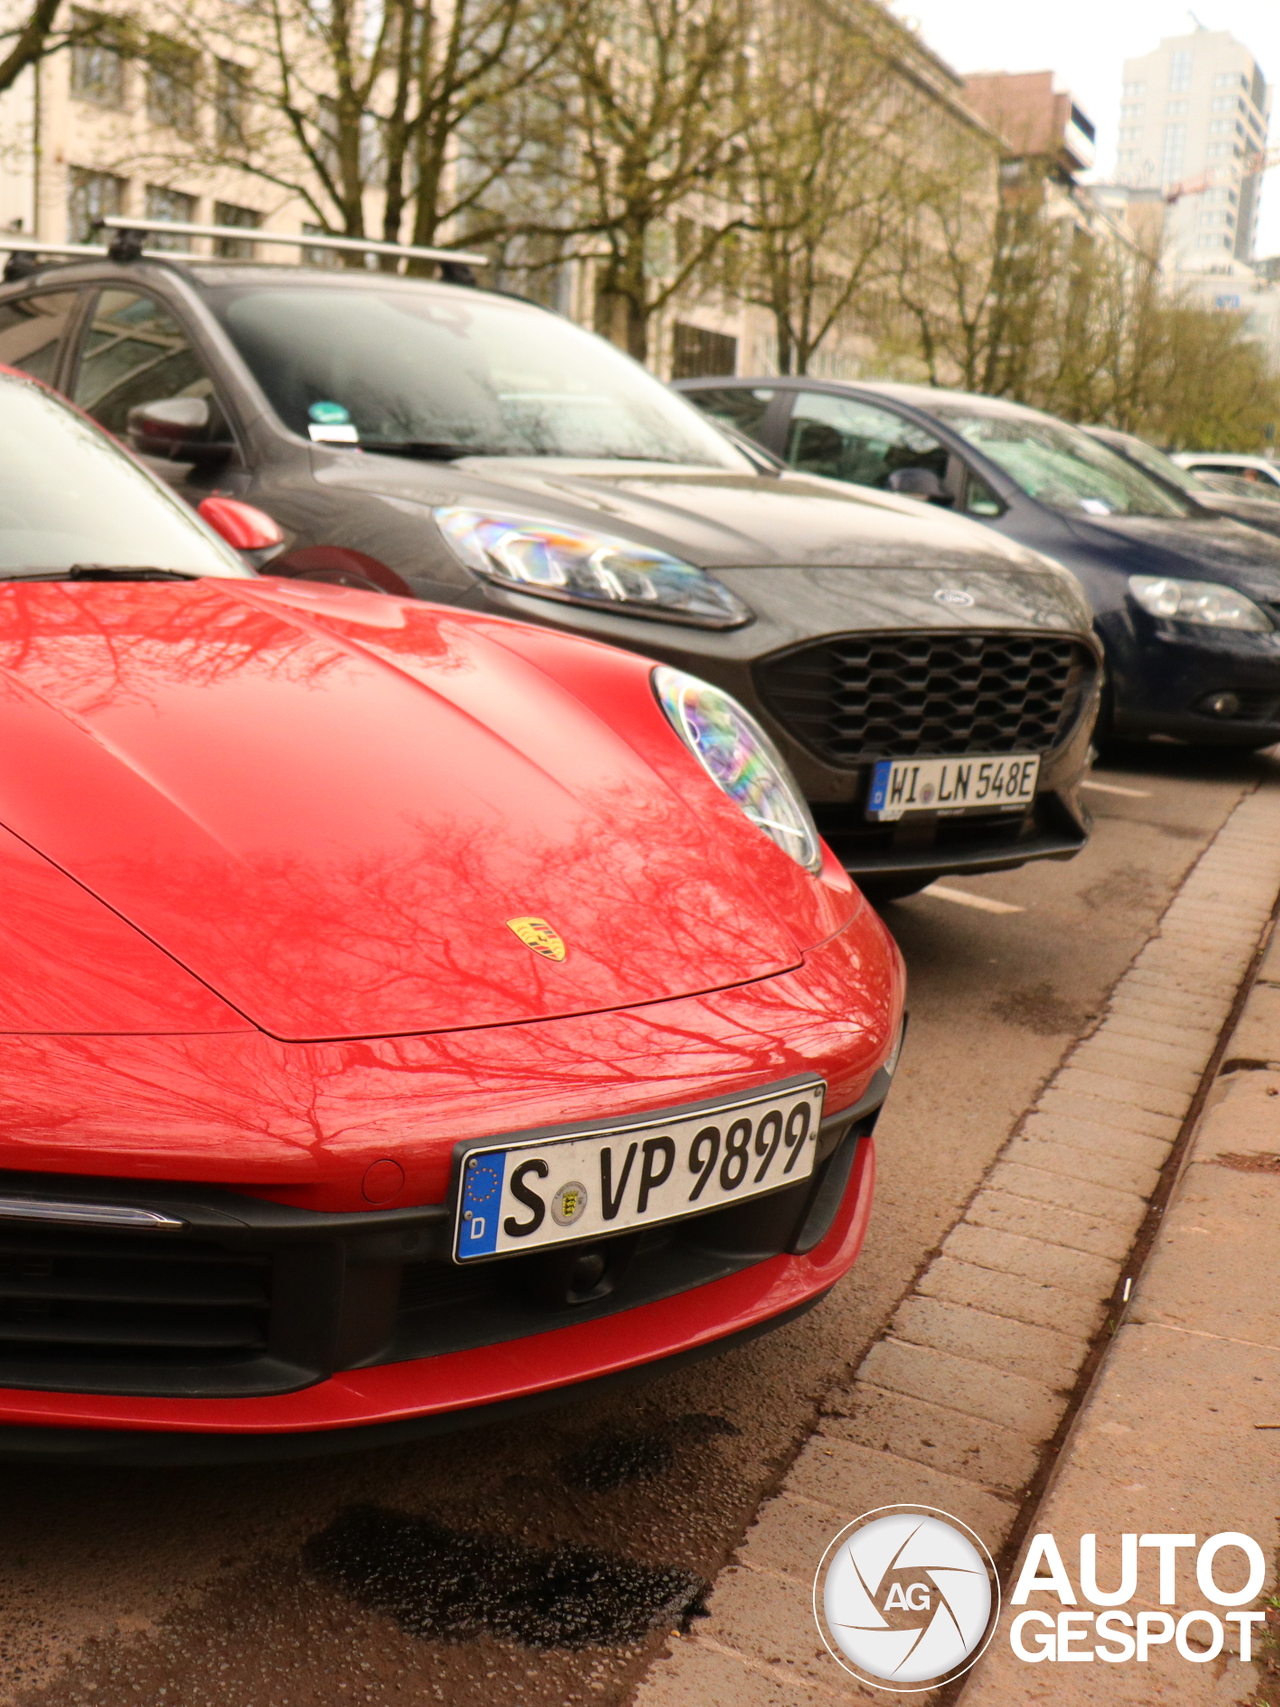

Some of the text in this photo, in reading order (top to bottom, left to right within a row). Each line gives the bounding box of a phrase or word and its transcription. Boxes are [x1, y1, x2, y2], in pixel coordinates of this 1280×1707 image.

[890, 761, 1036, 804] WI LN 548E
[503, 1158, 549, 1237] S
[600, 1136, 676, 1220] VP
[688, 1101, 811, 1202] 9899
[470, 1217, 486, 1240] D
